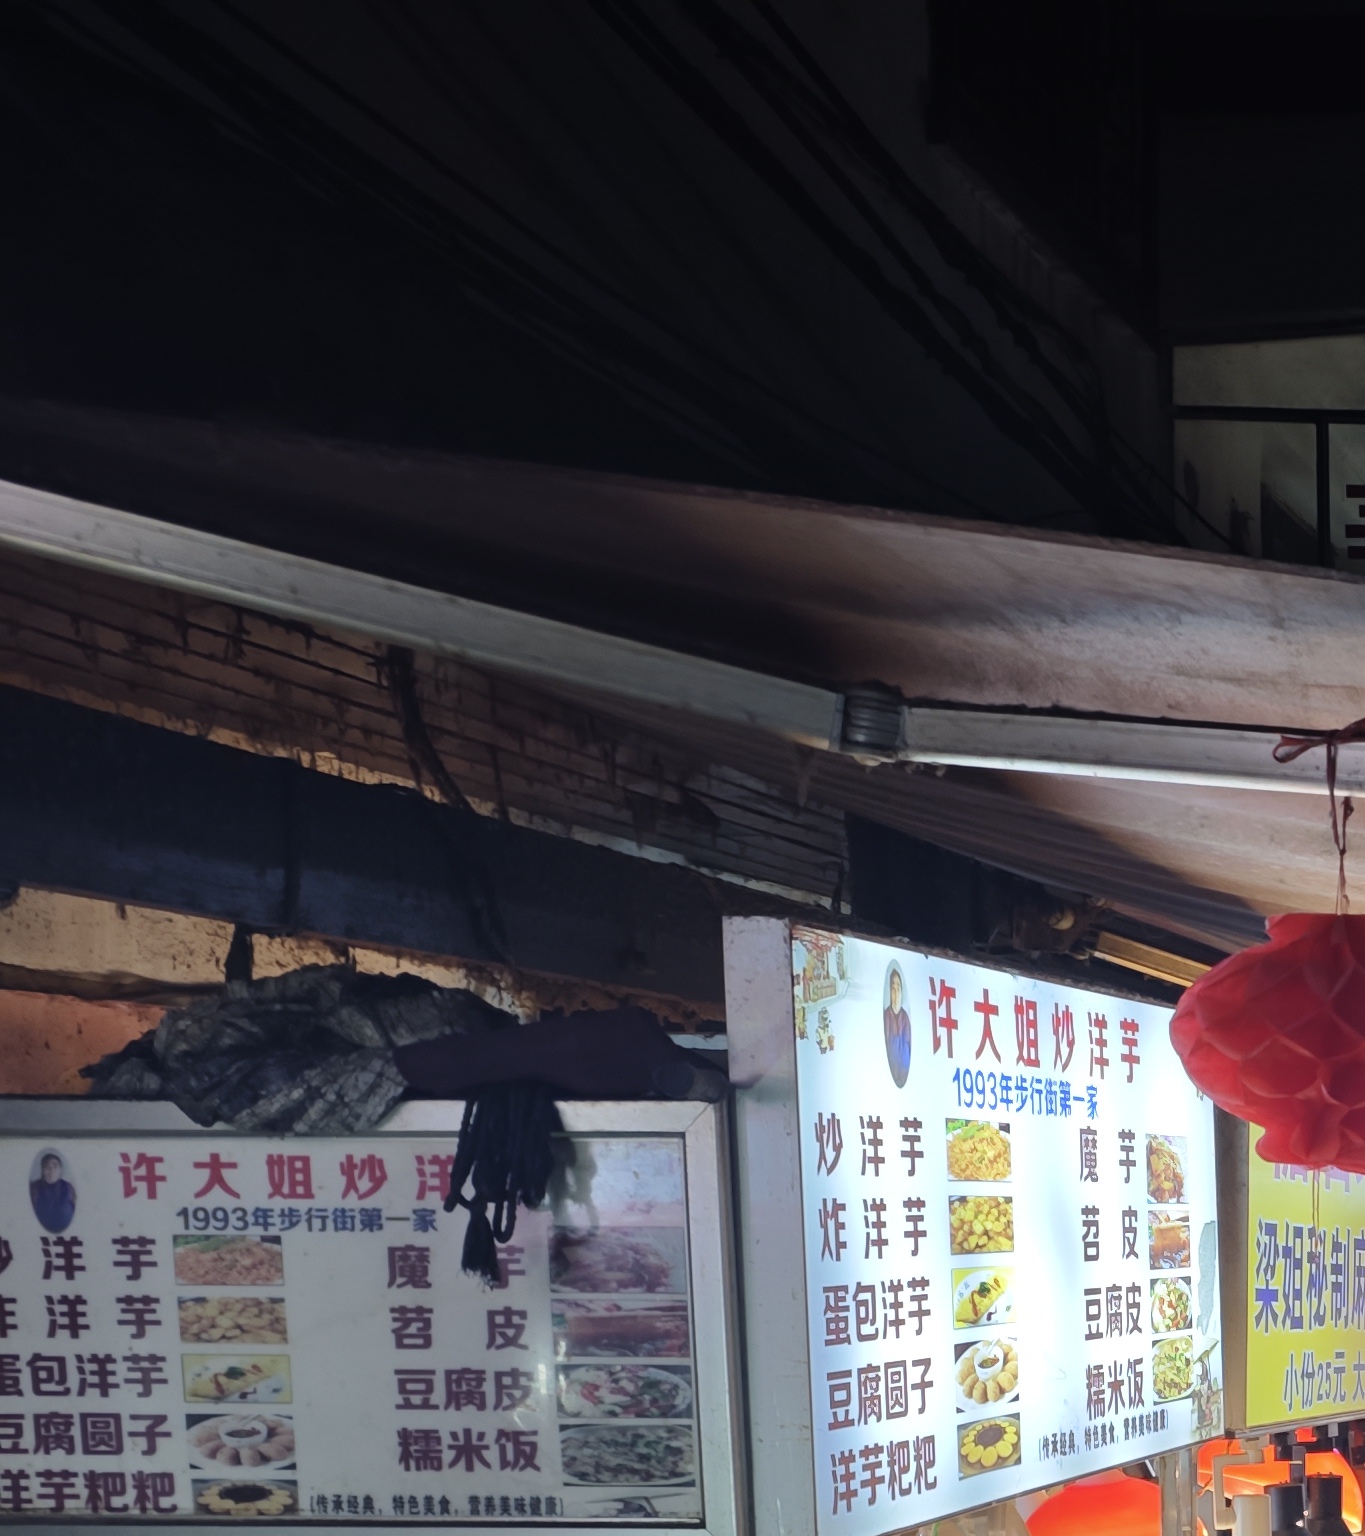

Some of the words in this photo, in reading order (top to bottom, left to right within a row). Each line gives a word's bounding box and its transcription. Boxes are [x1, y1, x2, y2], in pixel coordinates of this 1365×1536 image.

[928, 976, 1141, 1084] 许大姐炒洋芋
[953, 1069, 1100, 1121] 1993年步行街第一家
[815, 1111, 926, 1177] 炒洋芋
[1079, 1126, 1137, 1186] 魔芋
[175, 1205, 438, 1233] 1993年步行街第一家
[818, 1198, 928, 1264] 炸洋芋
[1081, 1205, 1139, 1263] 苕皮
[390, 1306, 529, 1350] 苕皮
[823, 1277, 931, 1347] 蛋包洋芋
[1084, 1282, 1144, 1341] 豆腐皮
[394, 1368, 534, 1412] 豆腐皮
[827, 1359, 935, 1432] 豆腐圆子
[1085, 1359, 1145, 1419] 糯米饭
[1284, 1350, 1346, 1412] 小份25元
[397, 1428, 541, 1473] 糯米饭
[830, 1435, 938, 1516] 洋芋粑粑
